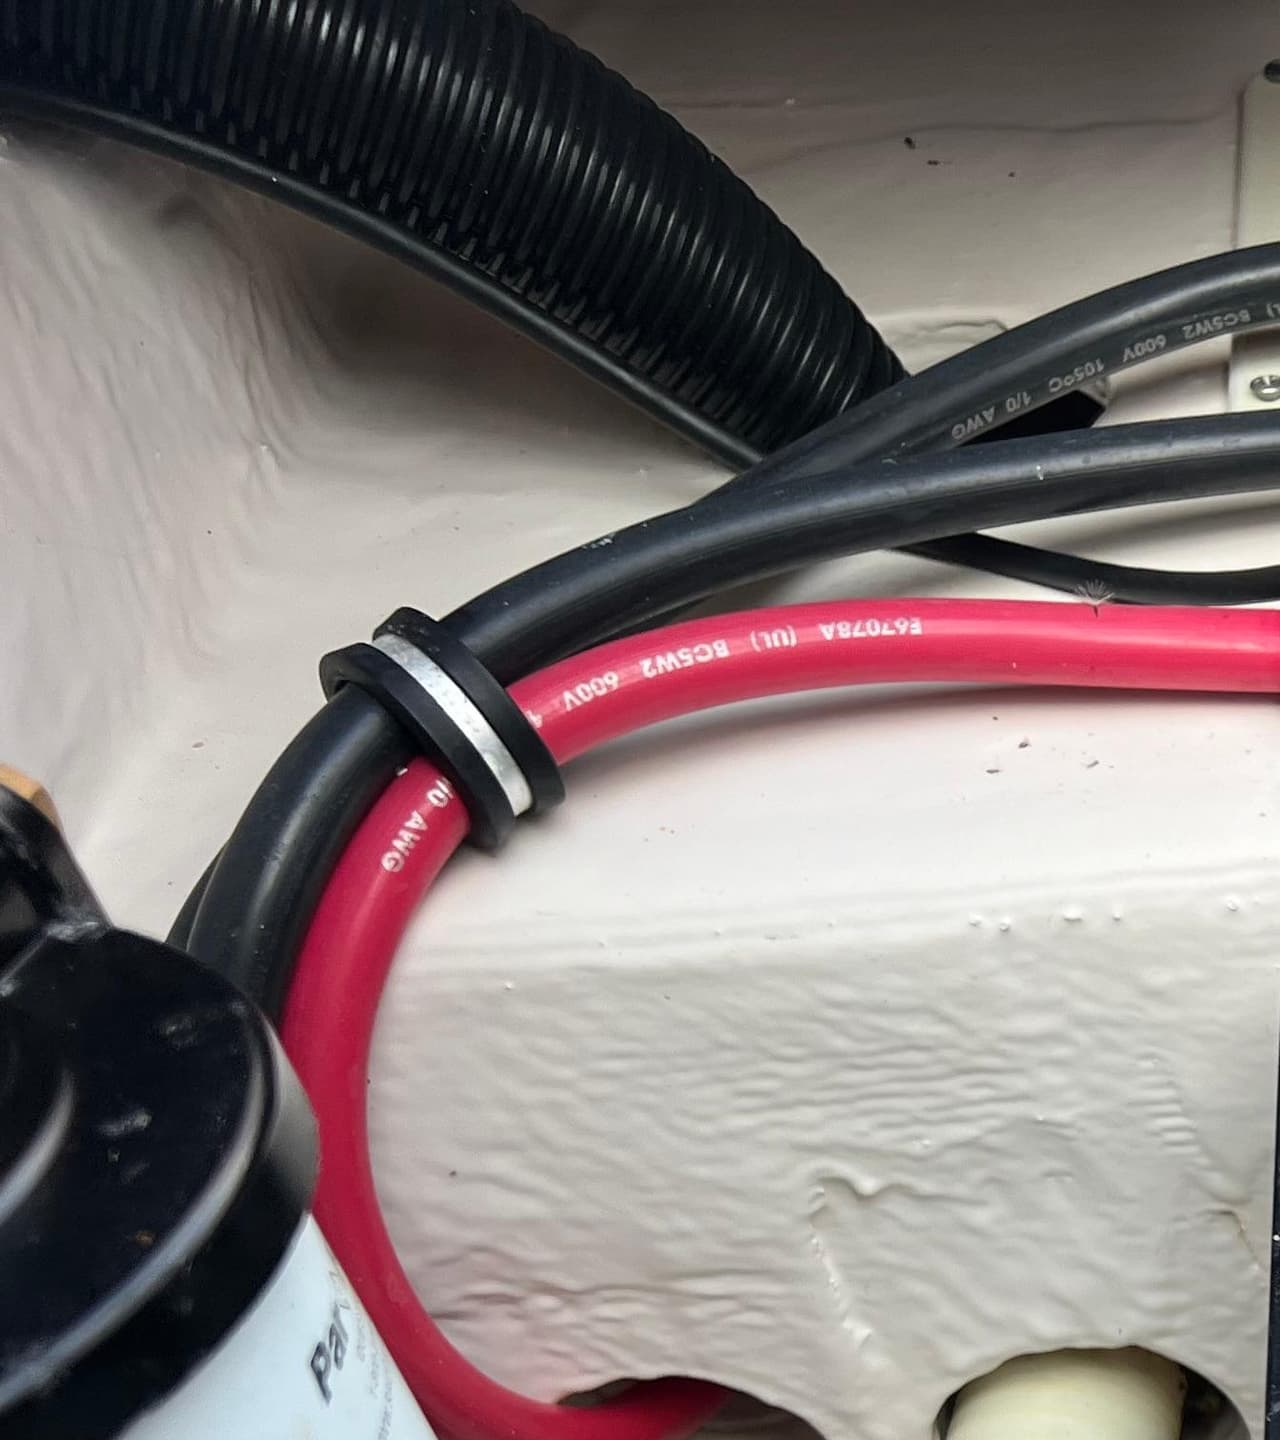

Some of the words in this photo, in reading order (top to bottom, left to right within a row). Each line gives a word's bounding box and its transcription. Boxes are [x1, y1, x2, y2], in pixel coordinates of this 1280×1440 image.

[1121, 334, 1167, 362] 600V
[950, 405, 996, 441] AWG
[751, 625, 798, 653] (UL)
[819, 617, 923, 640] E67078A
[561, 671, 620, 713] 600V
[381, 810, 428, 873] AWG
